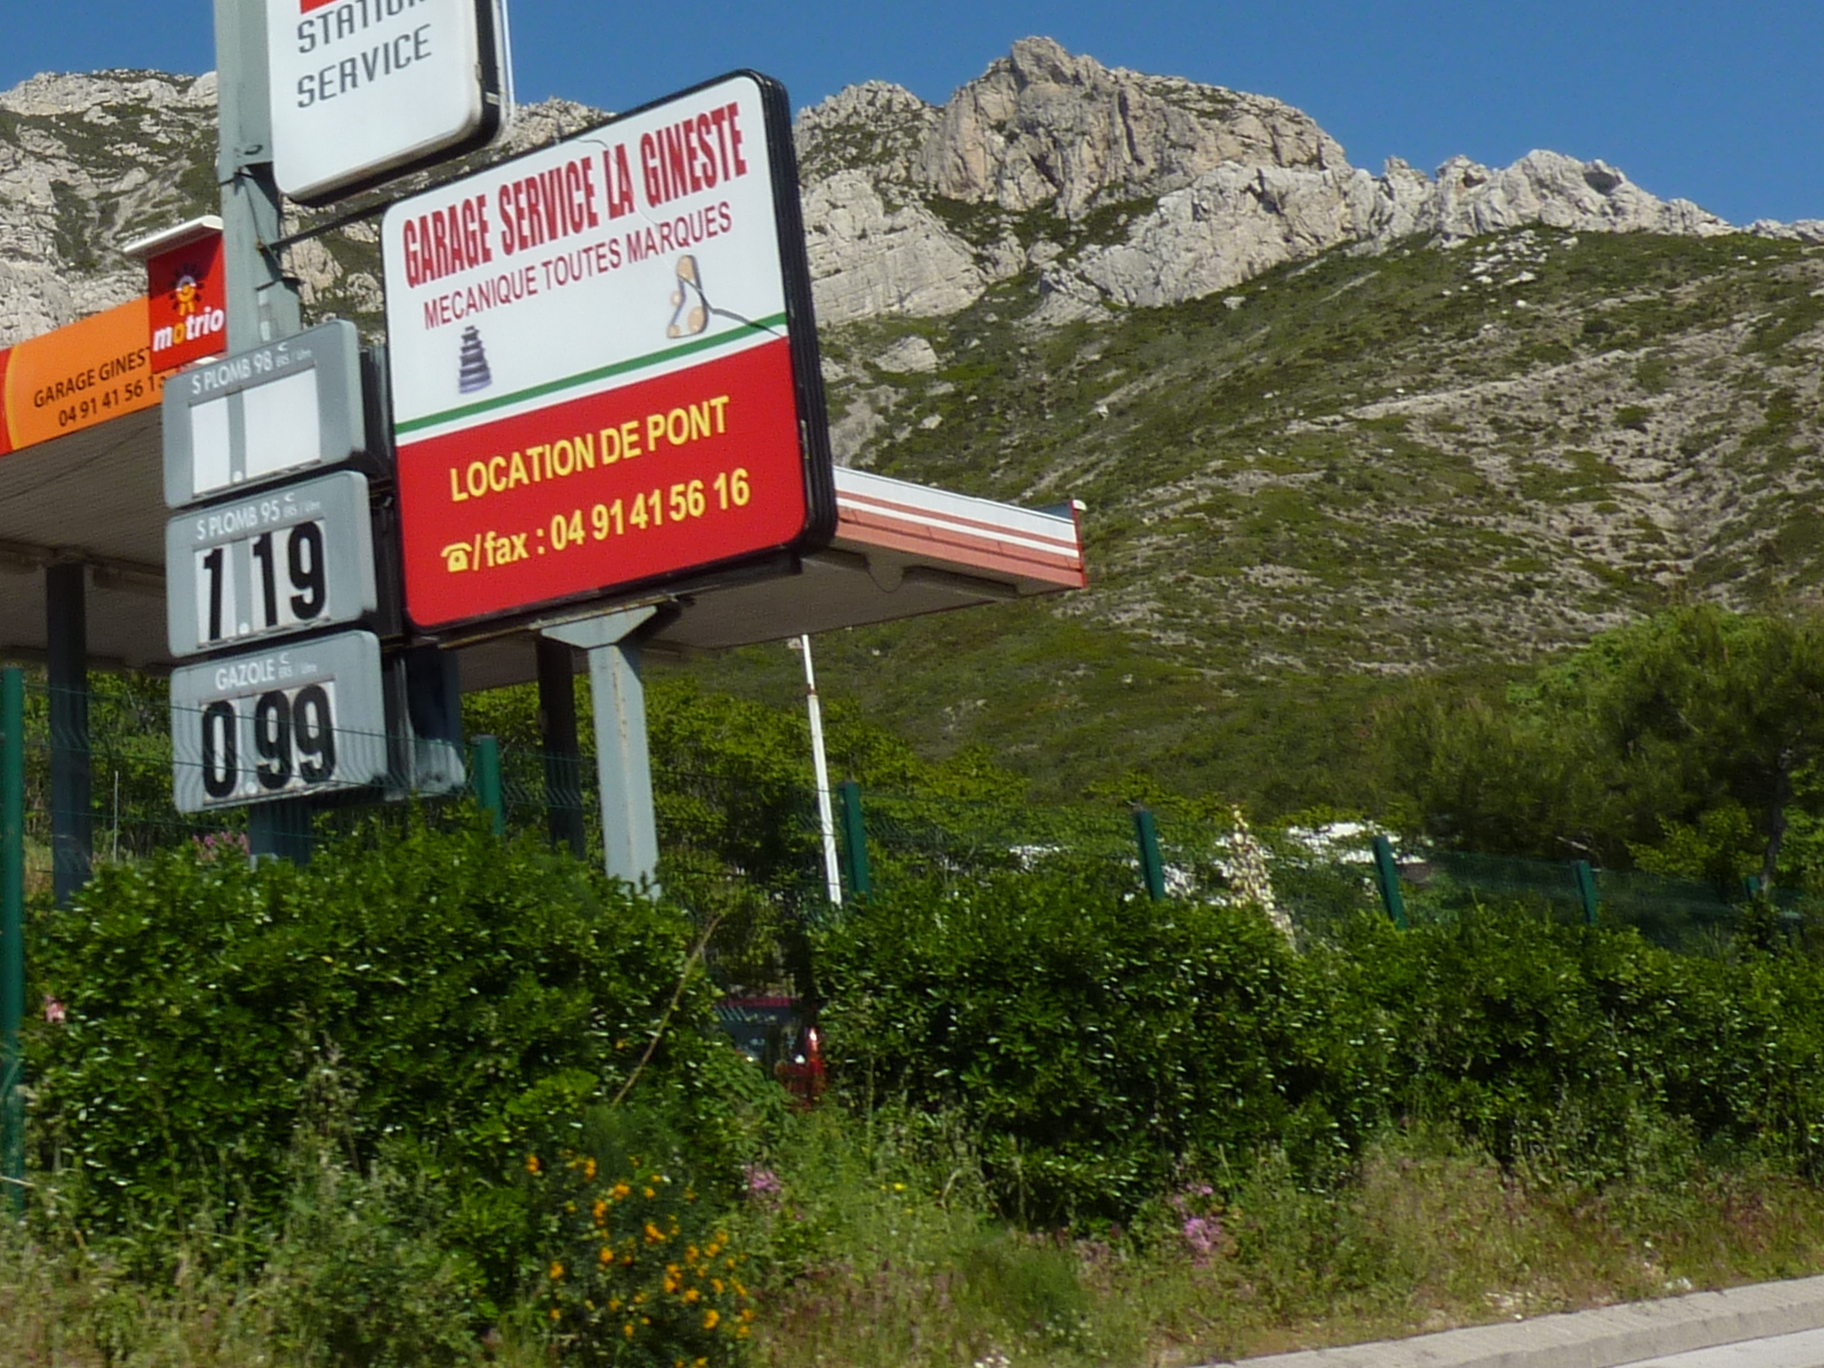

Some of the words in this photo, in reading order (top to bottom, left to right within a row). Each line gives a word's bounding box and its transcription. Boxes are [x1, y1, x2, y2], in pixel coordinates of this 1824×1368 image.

[297, 23, 431, 109] SERVICE
[403, 193, 493, 289] GARAGE
[498, 156, 599, 256] SERVICE
[602, 143, 635, 220] LA
[640, 101, 748, 209] GINESTE
[424, 265, 538, 330] MECANIQUE
[541, 238, 622, 291] TOUTES
[626, 201, 732, 264] MARQUES
[153, 306, 225, 352] motrio
[33, 368, 96, 409] GARAGE
[99, 346, 151, 382] GINES
[192, 374, 202, 395] S
[204, 358, 252, 392] PLOMB
[253, 350, 274, 374] 98
[59, 408, 77, 428] 04
[80, 397, 98, 419] 91
[102, 388, 120, 409] 41
[125, 381, 144, 403] 56
[450, 433, 596, 502] LOCATION
[600, 420, 642, 465] DE
[646, 395, 730, 452] PONT
[197, 519, 207, 540] S
[208, 506, 258, 537] PLOMB
[260, 500, 281, 524] 95
[550, 509, 586, 551] 04
[591, 498, 625, 541] 91
[629, 489, 663, 529] 41
[669, 479, 706, 522] 56
[713, 468, 751, 510] 16
[216, 659, 276, 691] GAZOLE
